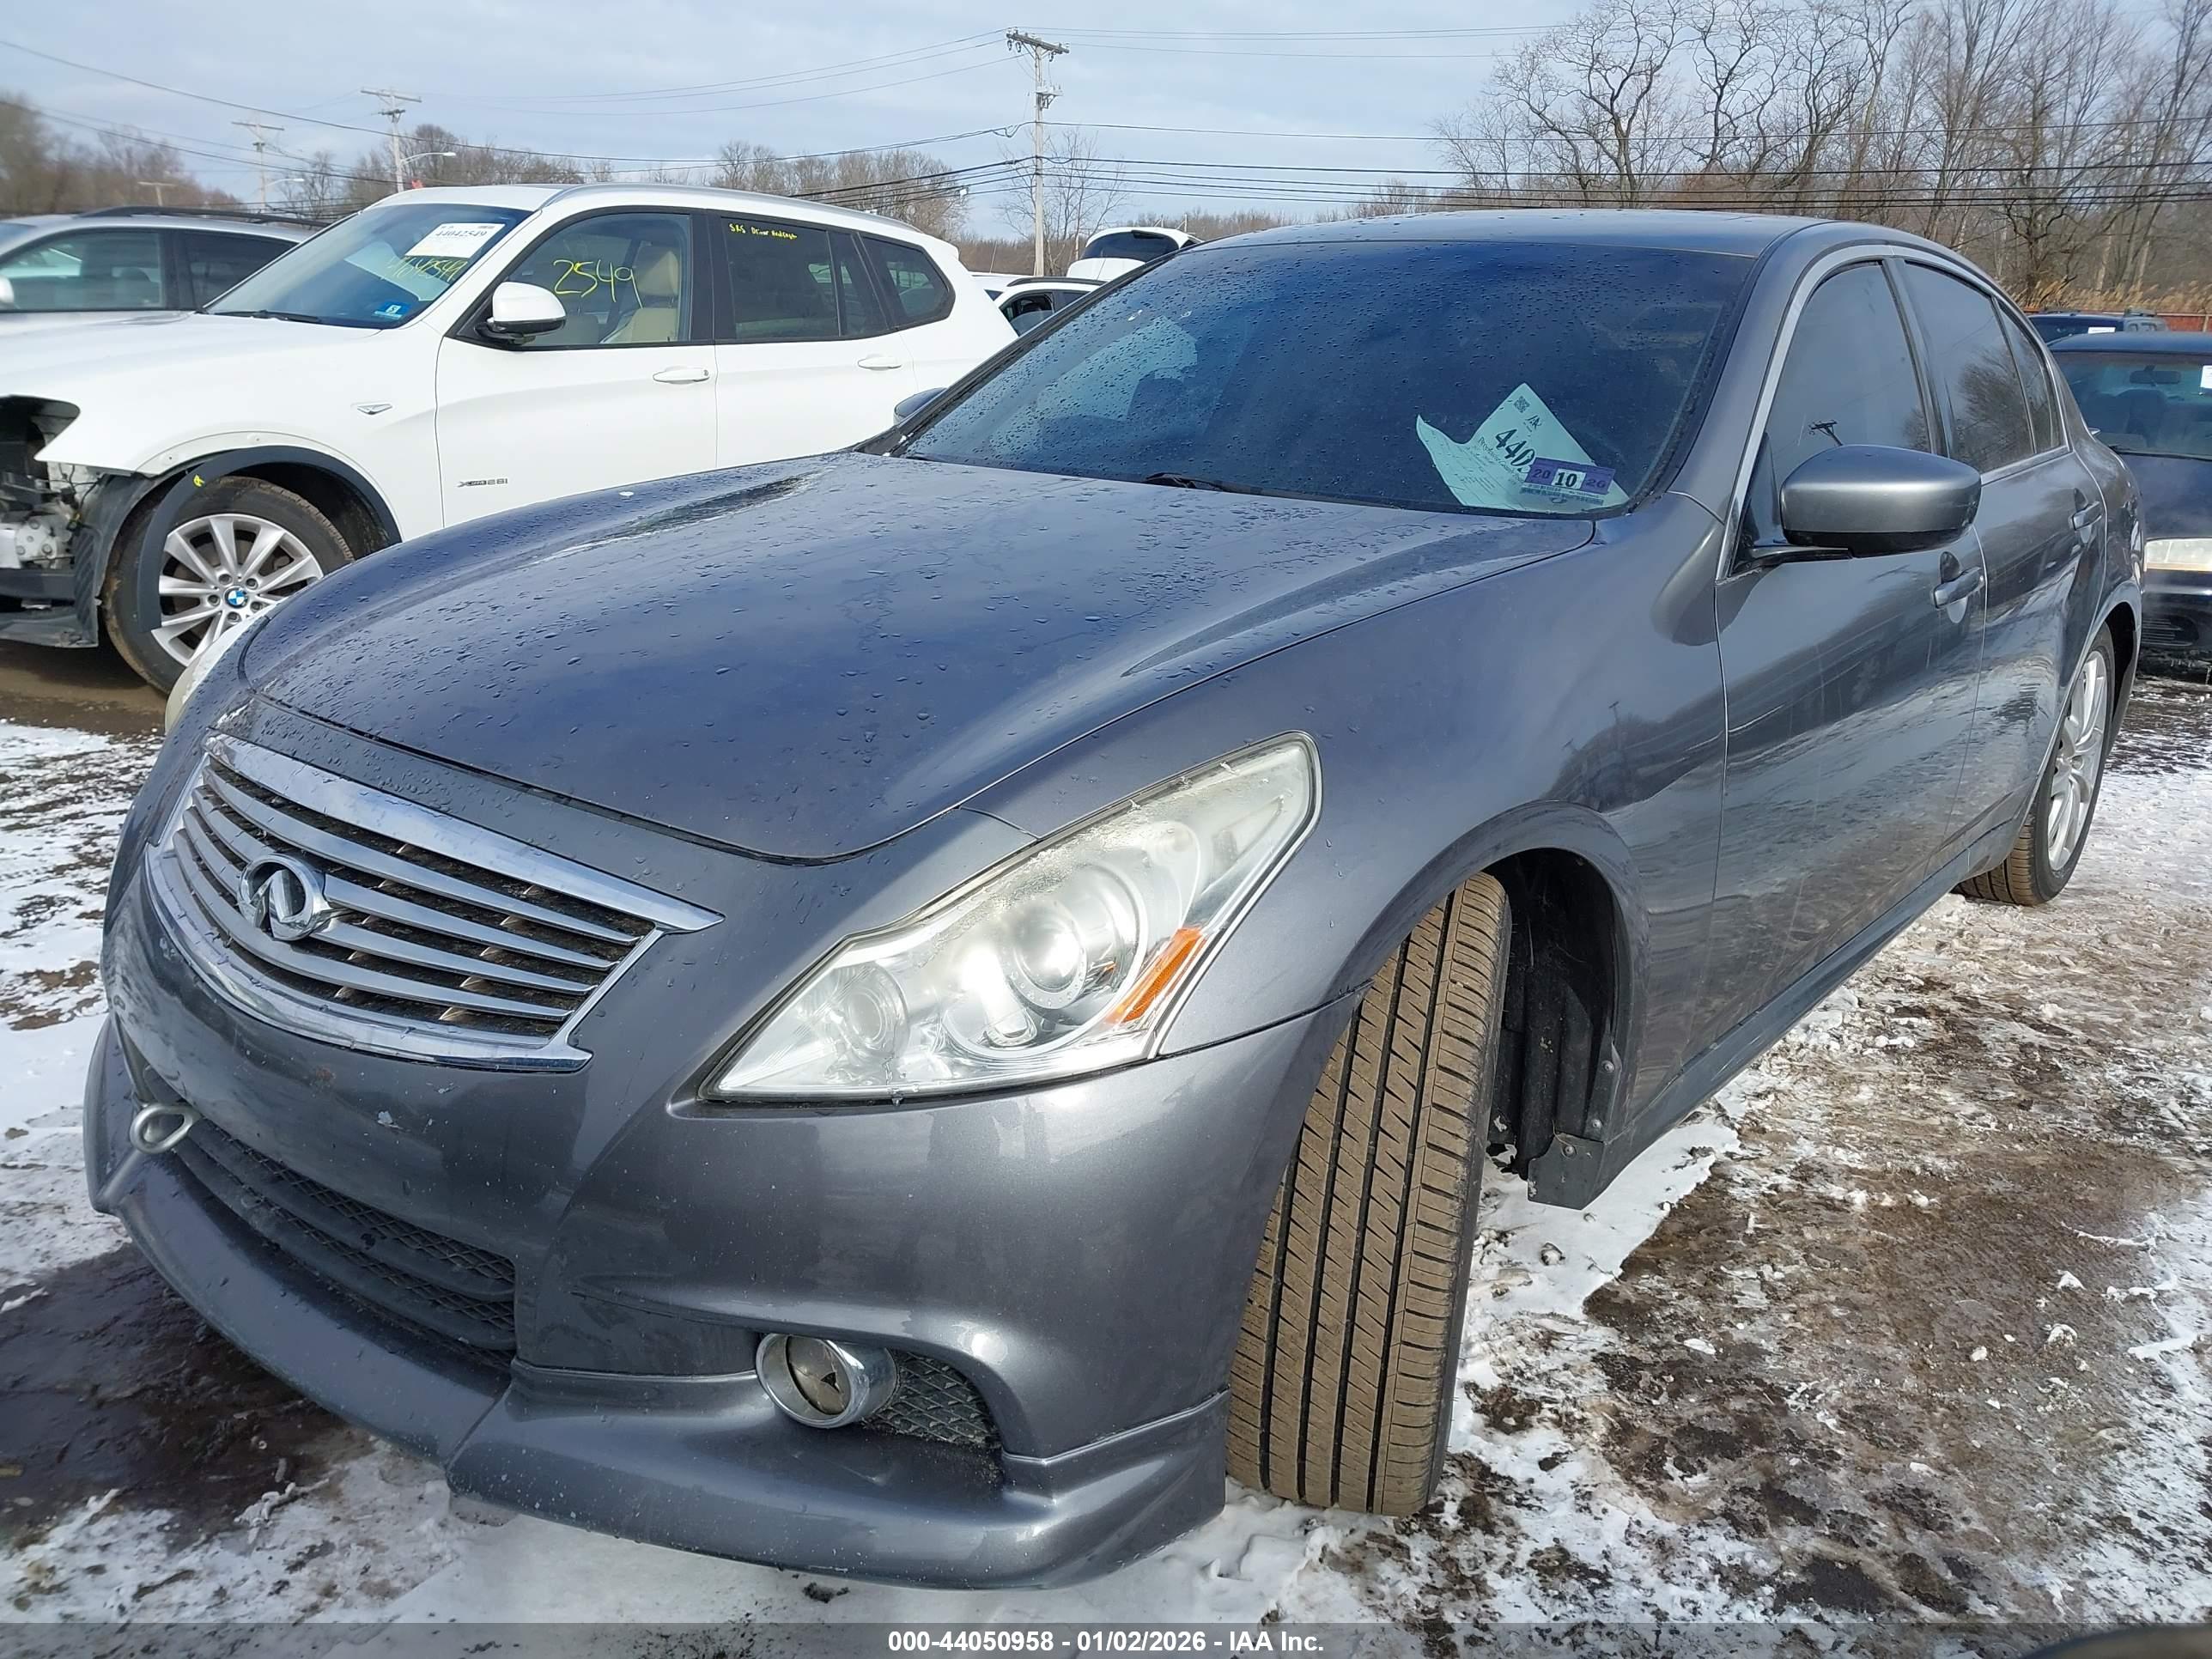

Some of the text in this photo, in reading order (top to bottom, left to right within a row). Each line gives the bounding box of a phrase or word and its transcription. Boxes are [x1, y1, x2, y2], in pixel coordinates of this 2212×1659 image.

[553, 259, 643, 309] 2549
[1495, 428, 1535, 474] 440
[1555, 471, 1577, 488] 10
